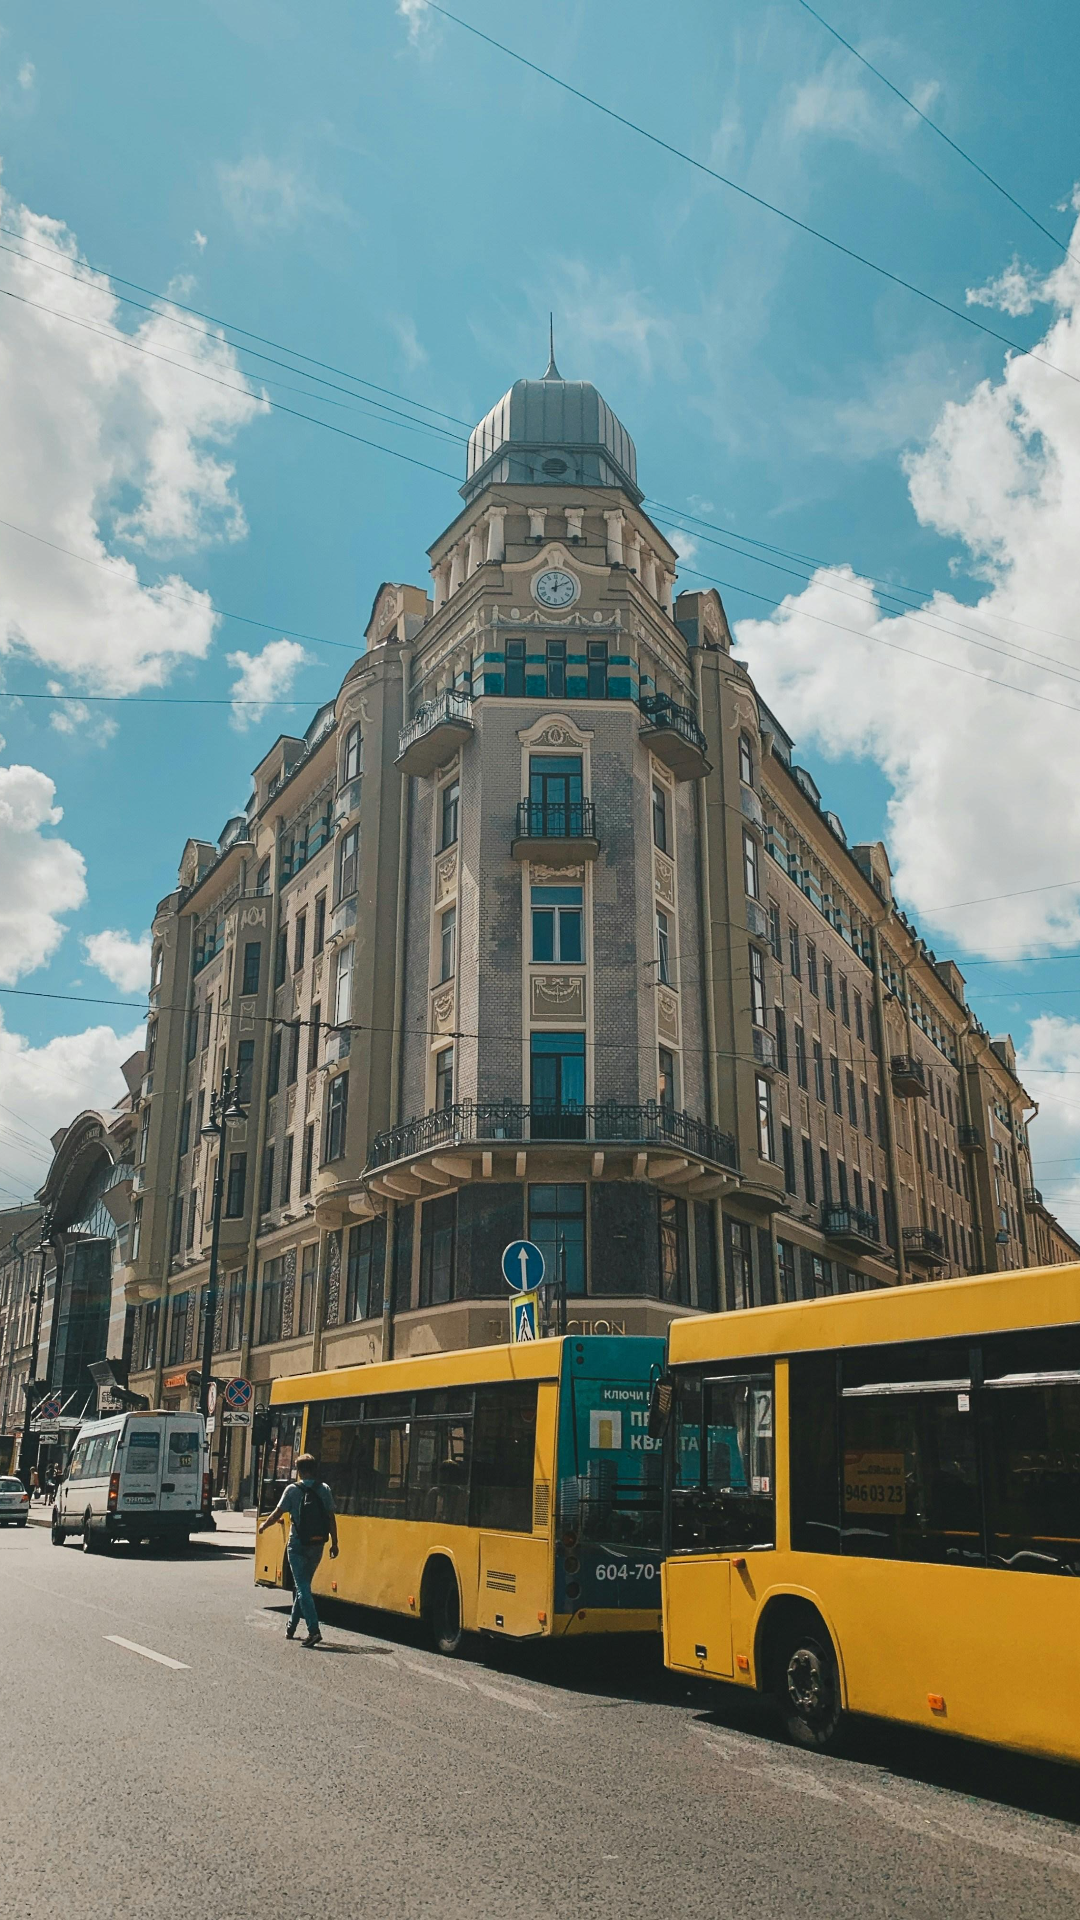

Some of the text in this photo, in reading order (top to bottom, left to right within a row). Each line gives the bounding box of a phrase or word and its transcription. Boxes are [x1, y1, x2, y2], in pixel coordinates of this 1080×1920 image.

[604, 1389, 644, 1401] КЛЮЧИ
[757, 1394, 771, 1431] 2
[631, 1434, 711, 1452] КВАТА
[845, 1484, 903, 1503] 946 03 23
